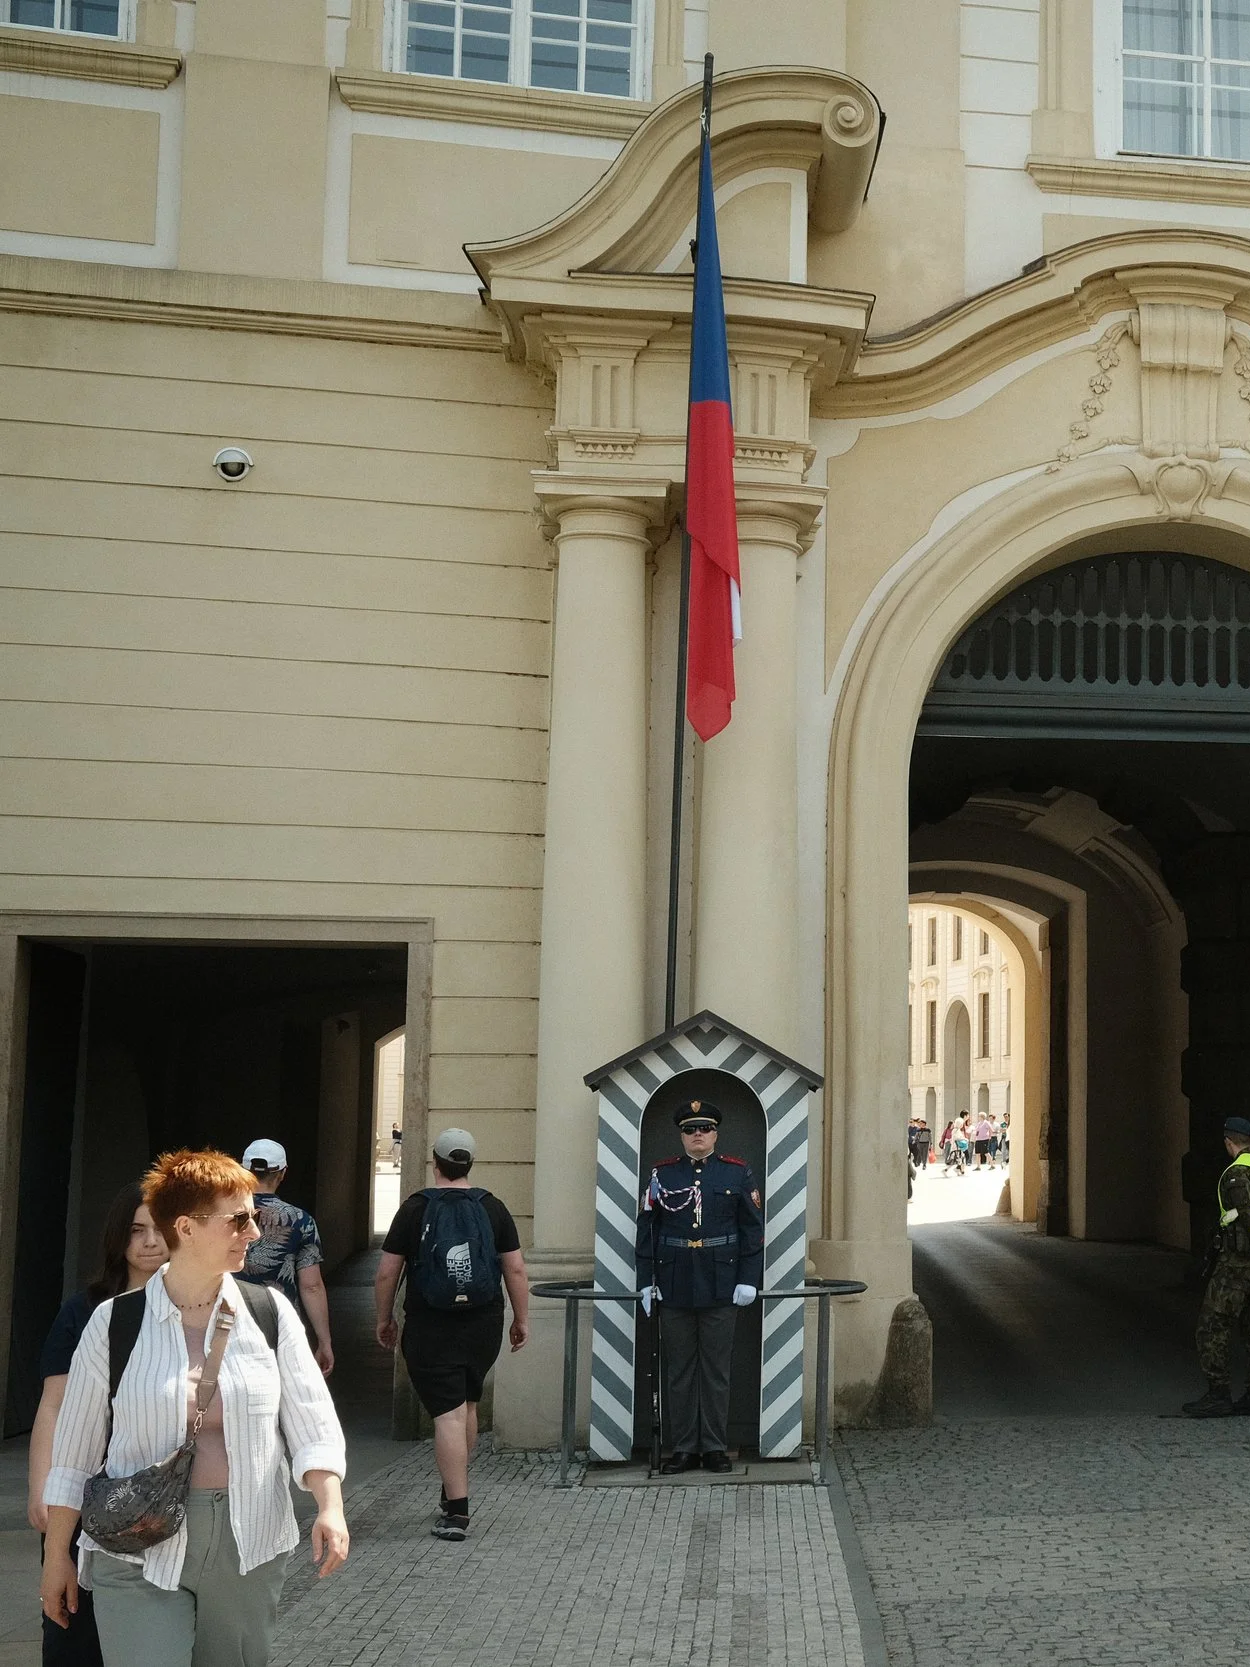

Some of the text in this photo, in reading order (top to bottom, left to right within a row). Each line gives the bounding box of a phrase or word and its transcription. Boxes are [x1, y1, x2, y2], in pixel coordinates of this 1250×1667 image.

[446, 1259, 456, 1278] THE
[455, 1261, 465, 1292] NORTH
[463, 1259, 473, 1282] FACE
